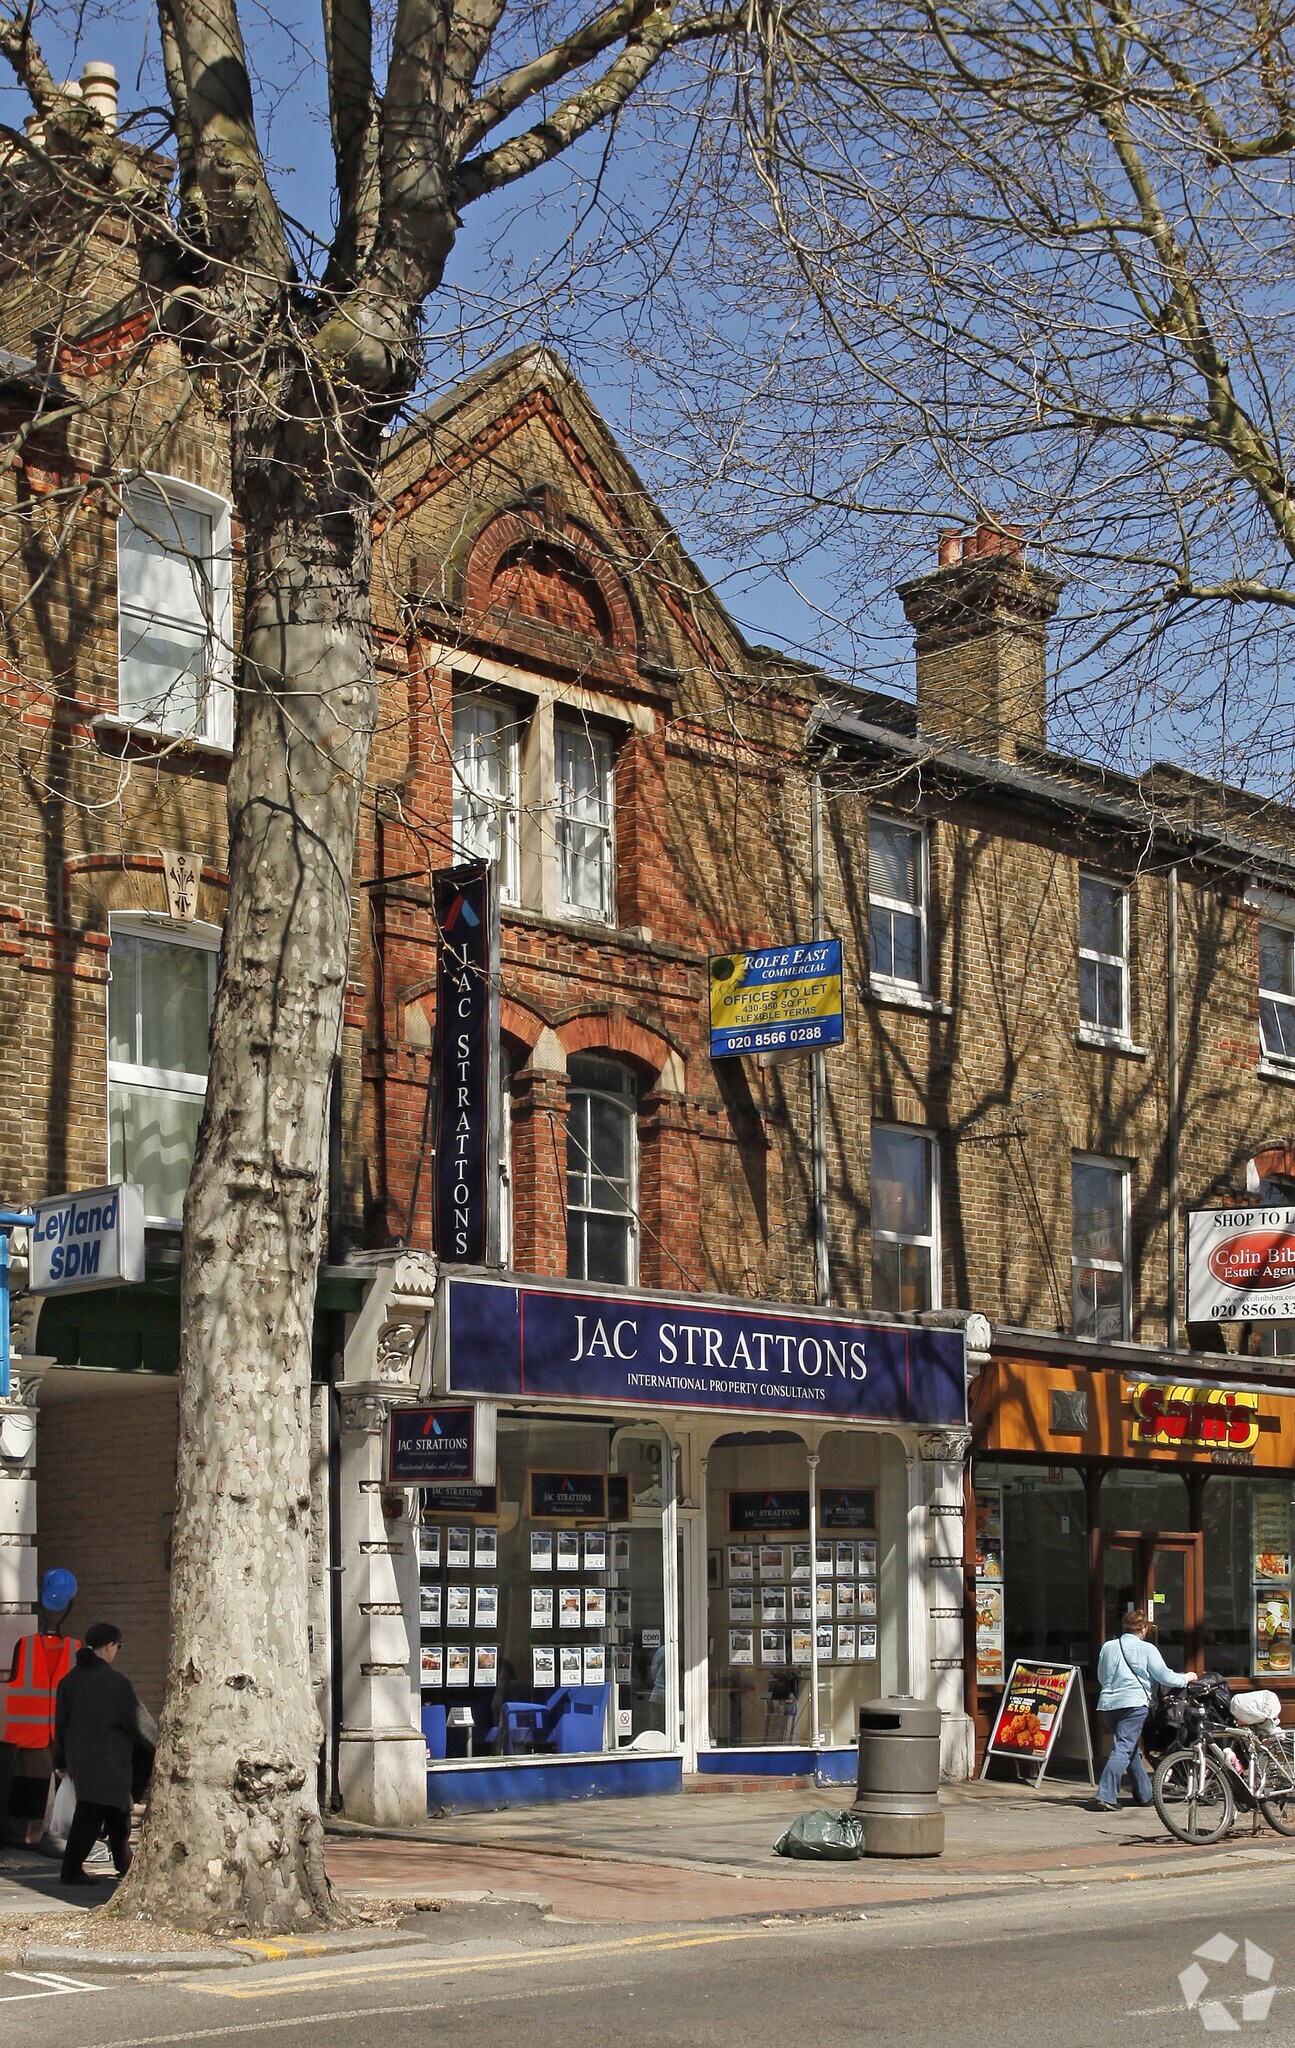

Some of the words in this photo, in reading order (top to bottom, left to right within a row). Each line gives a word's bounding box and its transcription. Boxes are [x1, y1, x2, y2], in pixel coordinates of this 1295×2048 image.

[793, 948, 829, 964] EAST
[761, 963, 826, 979] COMMERCIAL
[455, 943, 472, 1018] JAC
[723, 990, 778, 1006] OFFICES
[782, 987, 800, 999] TO
[803, 983, 827, 995] LET
[735, 1008, 781, 1023] FLEXIBLE
[784, 1006, 817, 1017] TERMS
[727, 1035, 752, 1049] 020
[755, 1031, 786, 1047] 8566
[790, 1027, 822, 1042] 0288
[453, 1034, 471, 1256] STRATTONS
[33, 1195, 118, 1243] Leyland
[1213, 1213, 1254, 1227] SHOP
[1258, 1212, 1280, 1225] TO
[49, 1239, 101, 1280] SDM
[1215, 1249, 1261, 1265] Colin
[1224, 1267, 1260, 1278] Estate
[1211, 1304, 1237, 1317] 020
[1241, 1303, 1276, 1316] 8566
[570, 1315, 638, 1362] JAC
[658, 1323, 867, 1380] STRATTONS
[627, 1373, 707, 1391] INTERNATIONAL
[709, 1379, 758, 1394] PROPERTY
[760, 1384, 826, 1400] CONSULTANTS
[397, 1440, 413, 1453] JAC
[416, 1438, 468, 1450] STRATTONS
[432, 1487, 444, 1495] JAC
[446, 1488, 483, 1497] STRATTONS
[544, 1493, 555, 1502] JAC
[557, 1493, 592, 1502] STRATTONS
[759, 1509, 801, 1517] STRATTONS
[644, 1634, 660, 1643] open
[1007, 1703, 1031, 1714] £1.99
